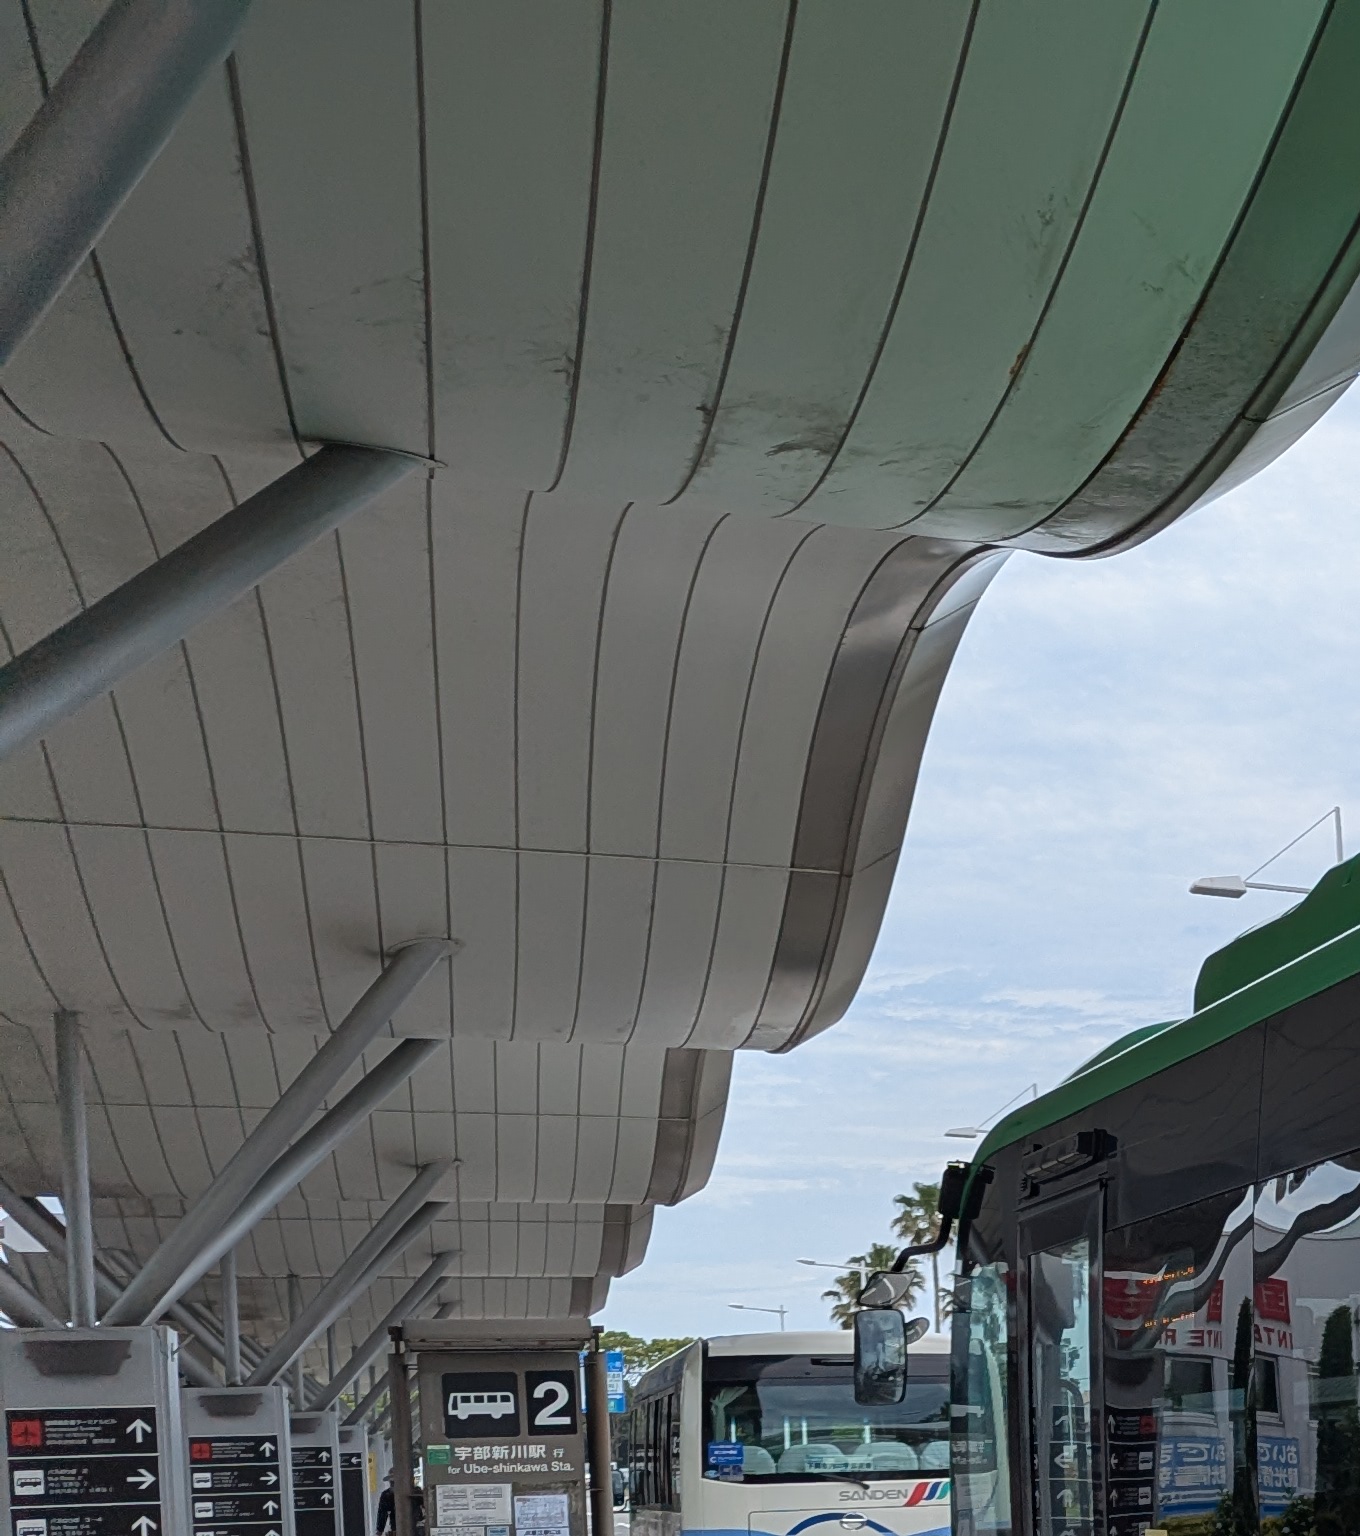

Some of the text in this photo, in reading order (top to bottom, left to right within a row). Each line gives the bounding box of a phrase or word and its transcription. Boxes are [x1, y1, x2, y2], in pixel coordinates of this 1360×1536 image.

[533, 1380, 572, 1426] 2
[454, 1444, 546, 1461] 宇部新川駅
[552, 1448, 565, 1459] 行
[447, 1460, 575, 1475] for Ube-shinkawa Sta.
[838, 1489, 909, 1502] SANDEN
